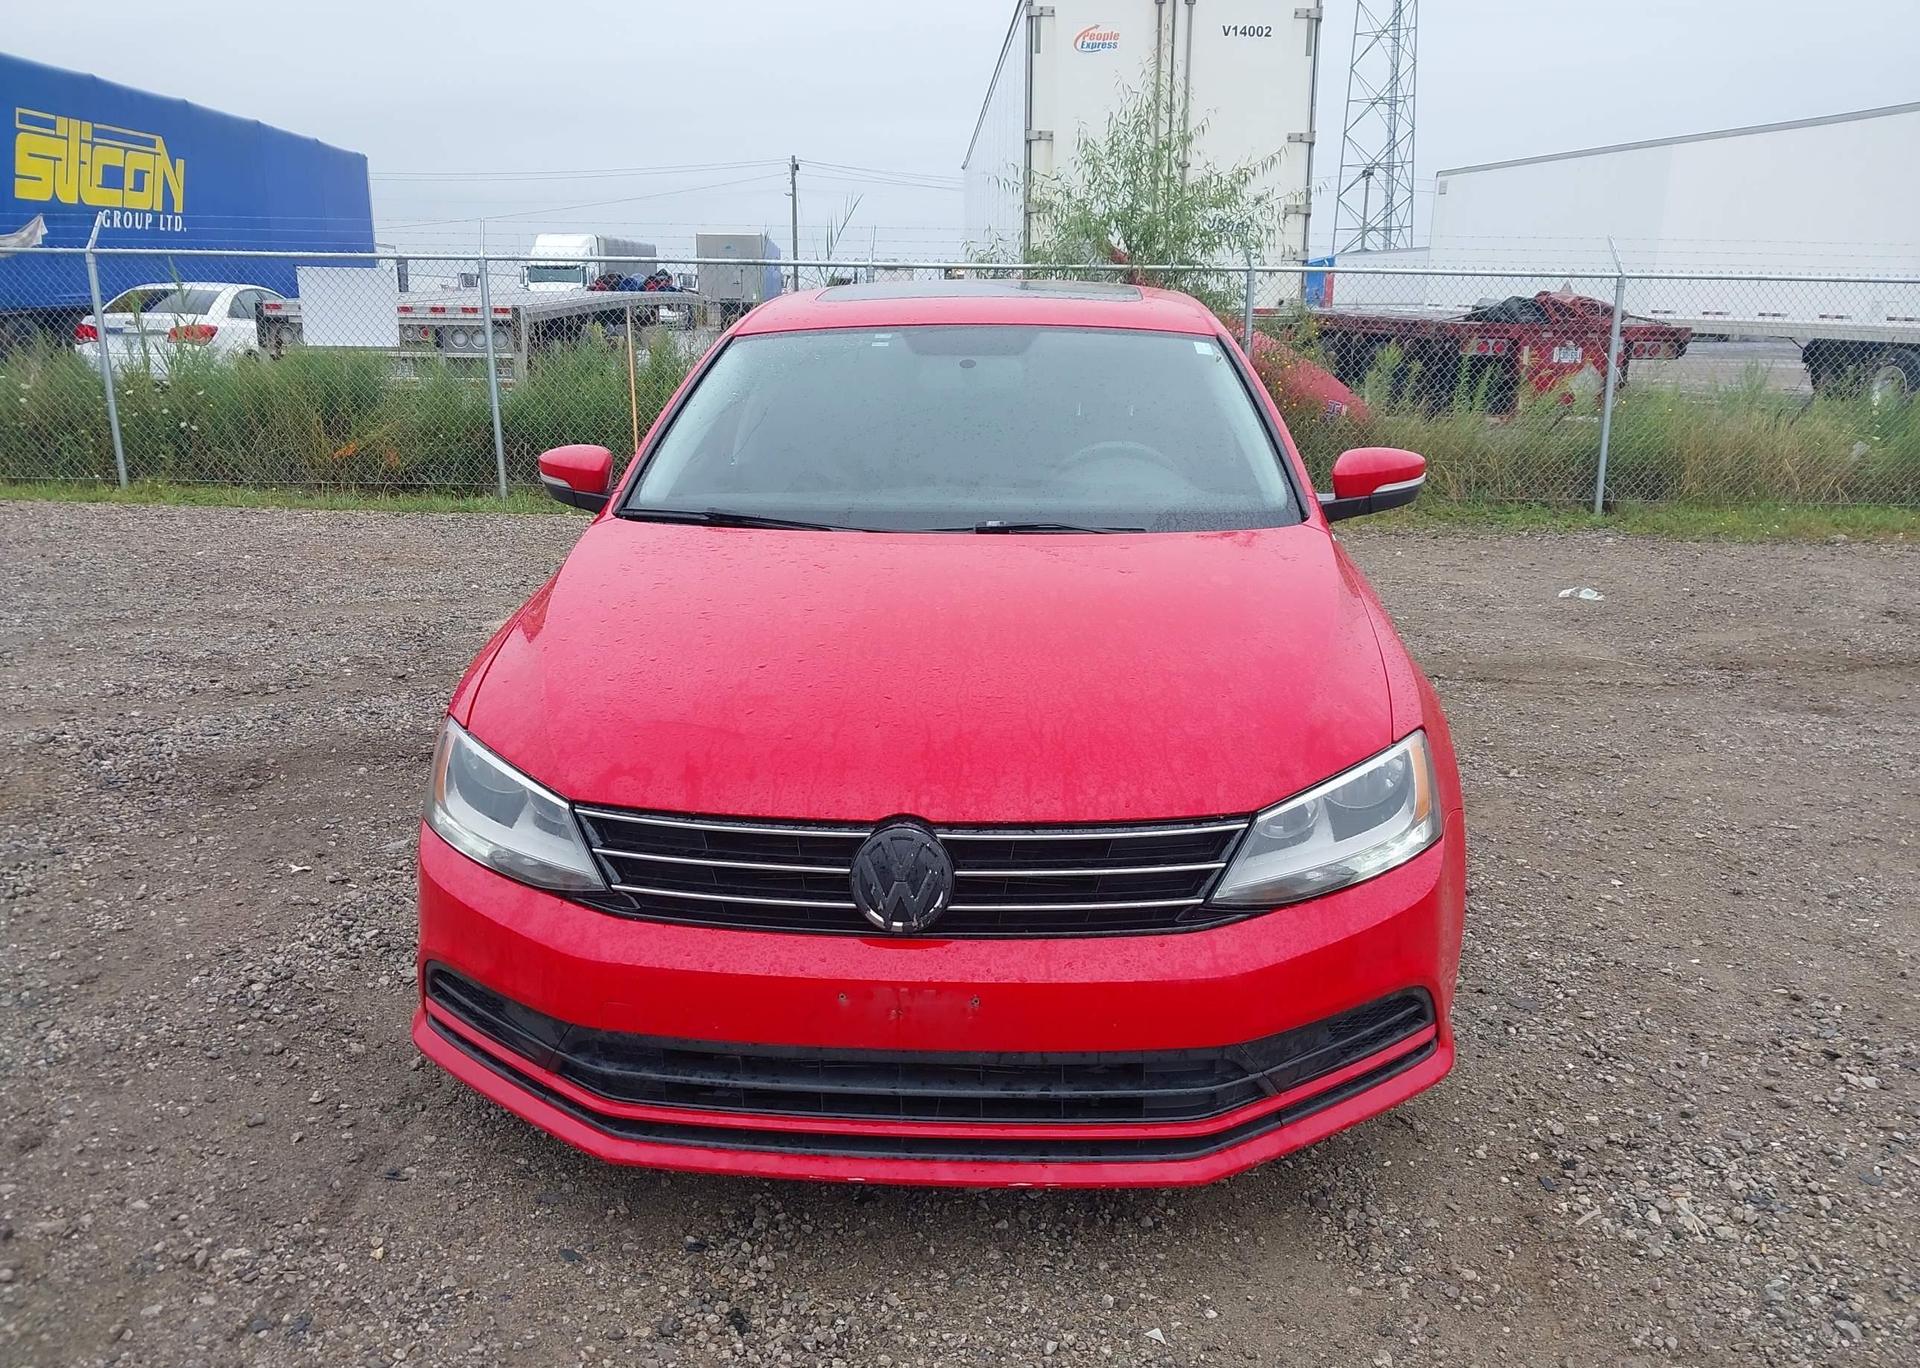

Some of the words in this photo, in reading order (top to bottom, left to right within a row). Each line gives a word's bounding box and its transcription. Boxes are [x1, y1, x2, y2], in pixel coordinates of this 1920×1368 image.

[1082, 31, 1120, 41] People
[1222, 25, 1272, 38] V14002
[1081, 40, 1118, 50] Express
[101, 209, 153, 231] GROUP
[159, 214, 188, 233] LTD.
